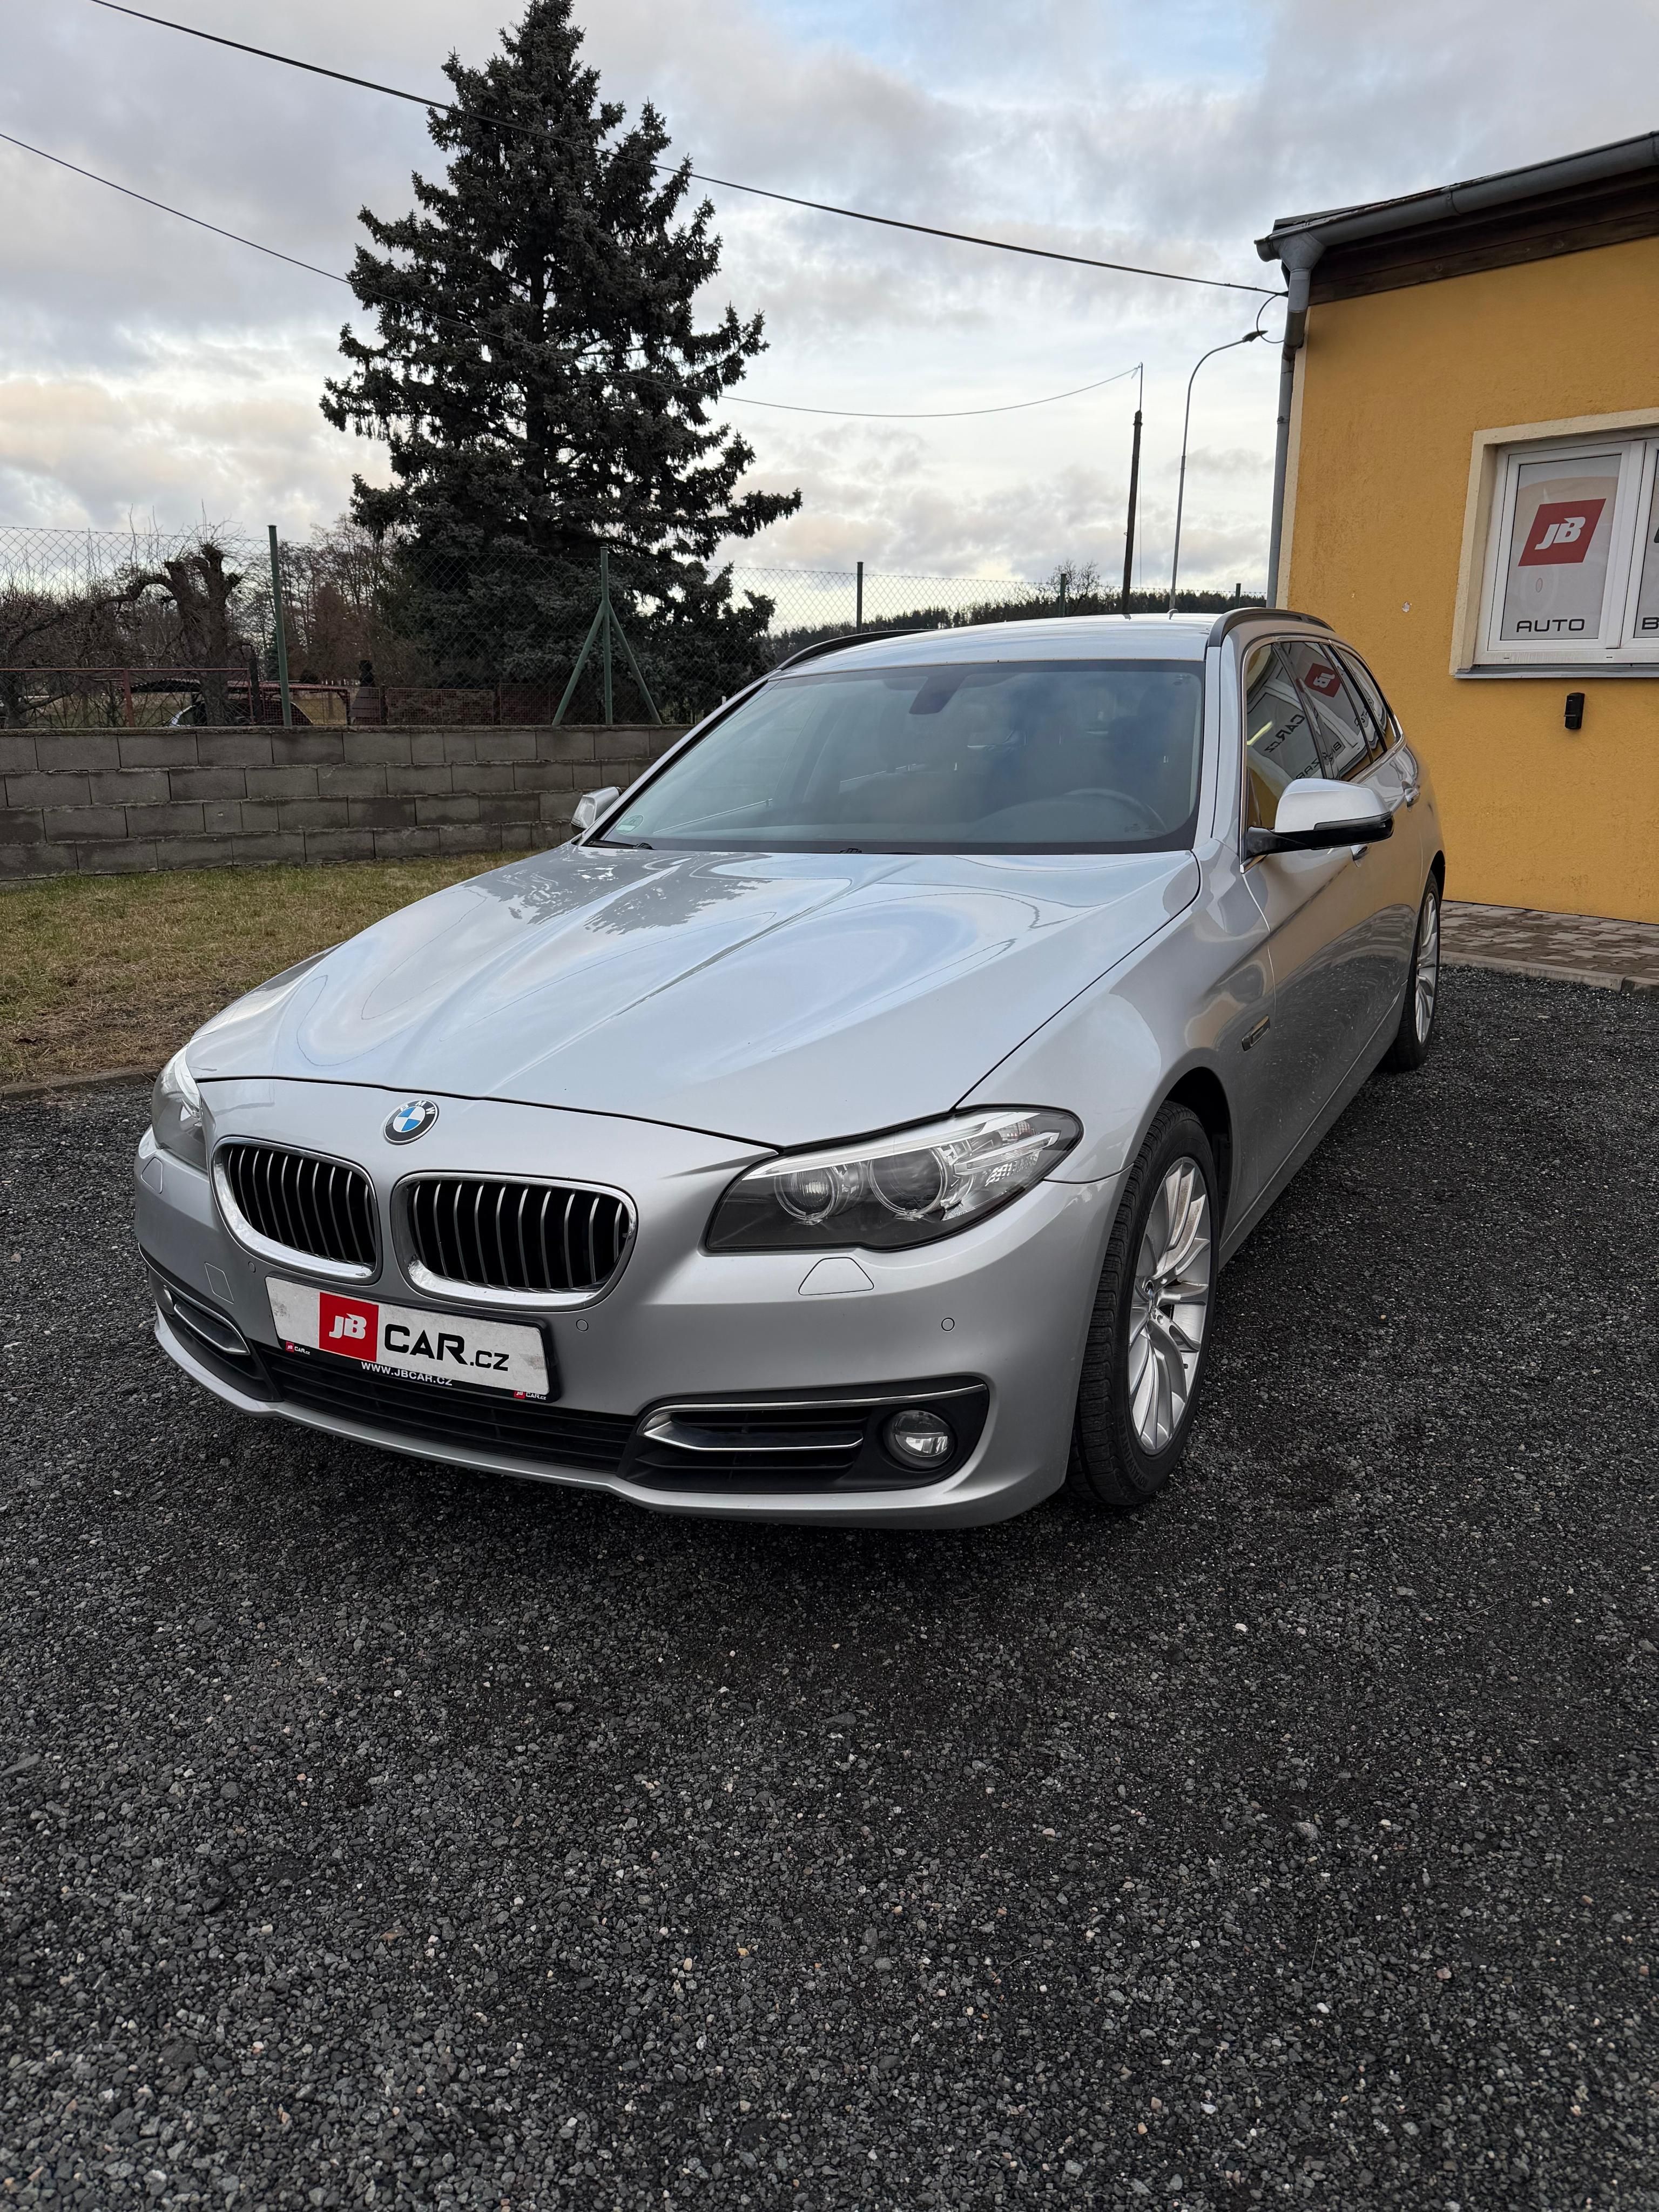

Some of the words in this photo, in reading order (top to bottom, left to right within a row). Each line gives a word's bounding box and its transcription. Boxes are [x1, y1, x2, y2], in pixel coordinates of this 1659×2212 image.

[1534, 516, 1586, 550] JB
[1516, 618, 1584, 632] AUTO
[400, 1101, 435, 1115] BMW
[329, 1313, 367, 1339] JB
[361, 1361, 453, 1386] WWW.JBCAR.CZ
